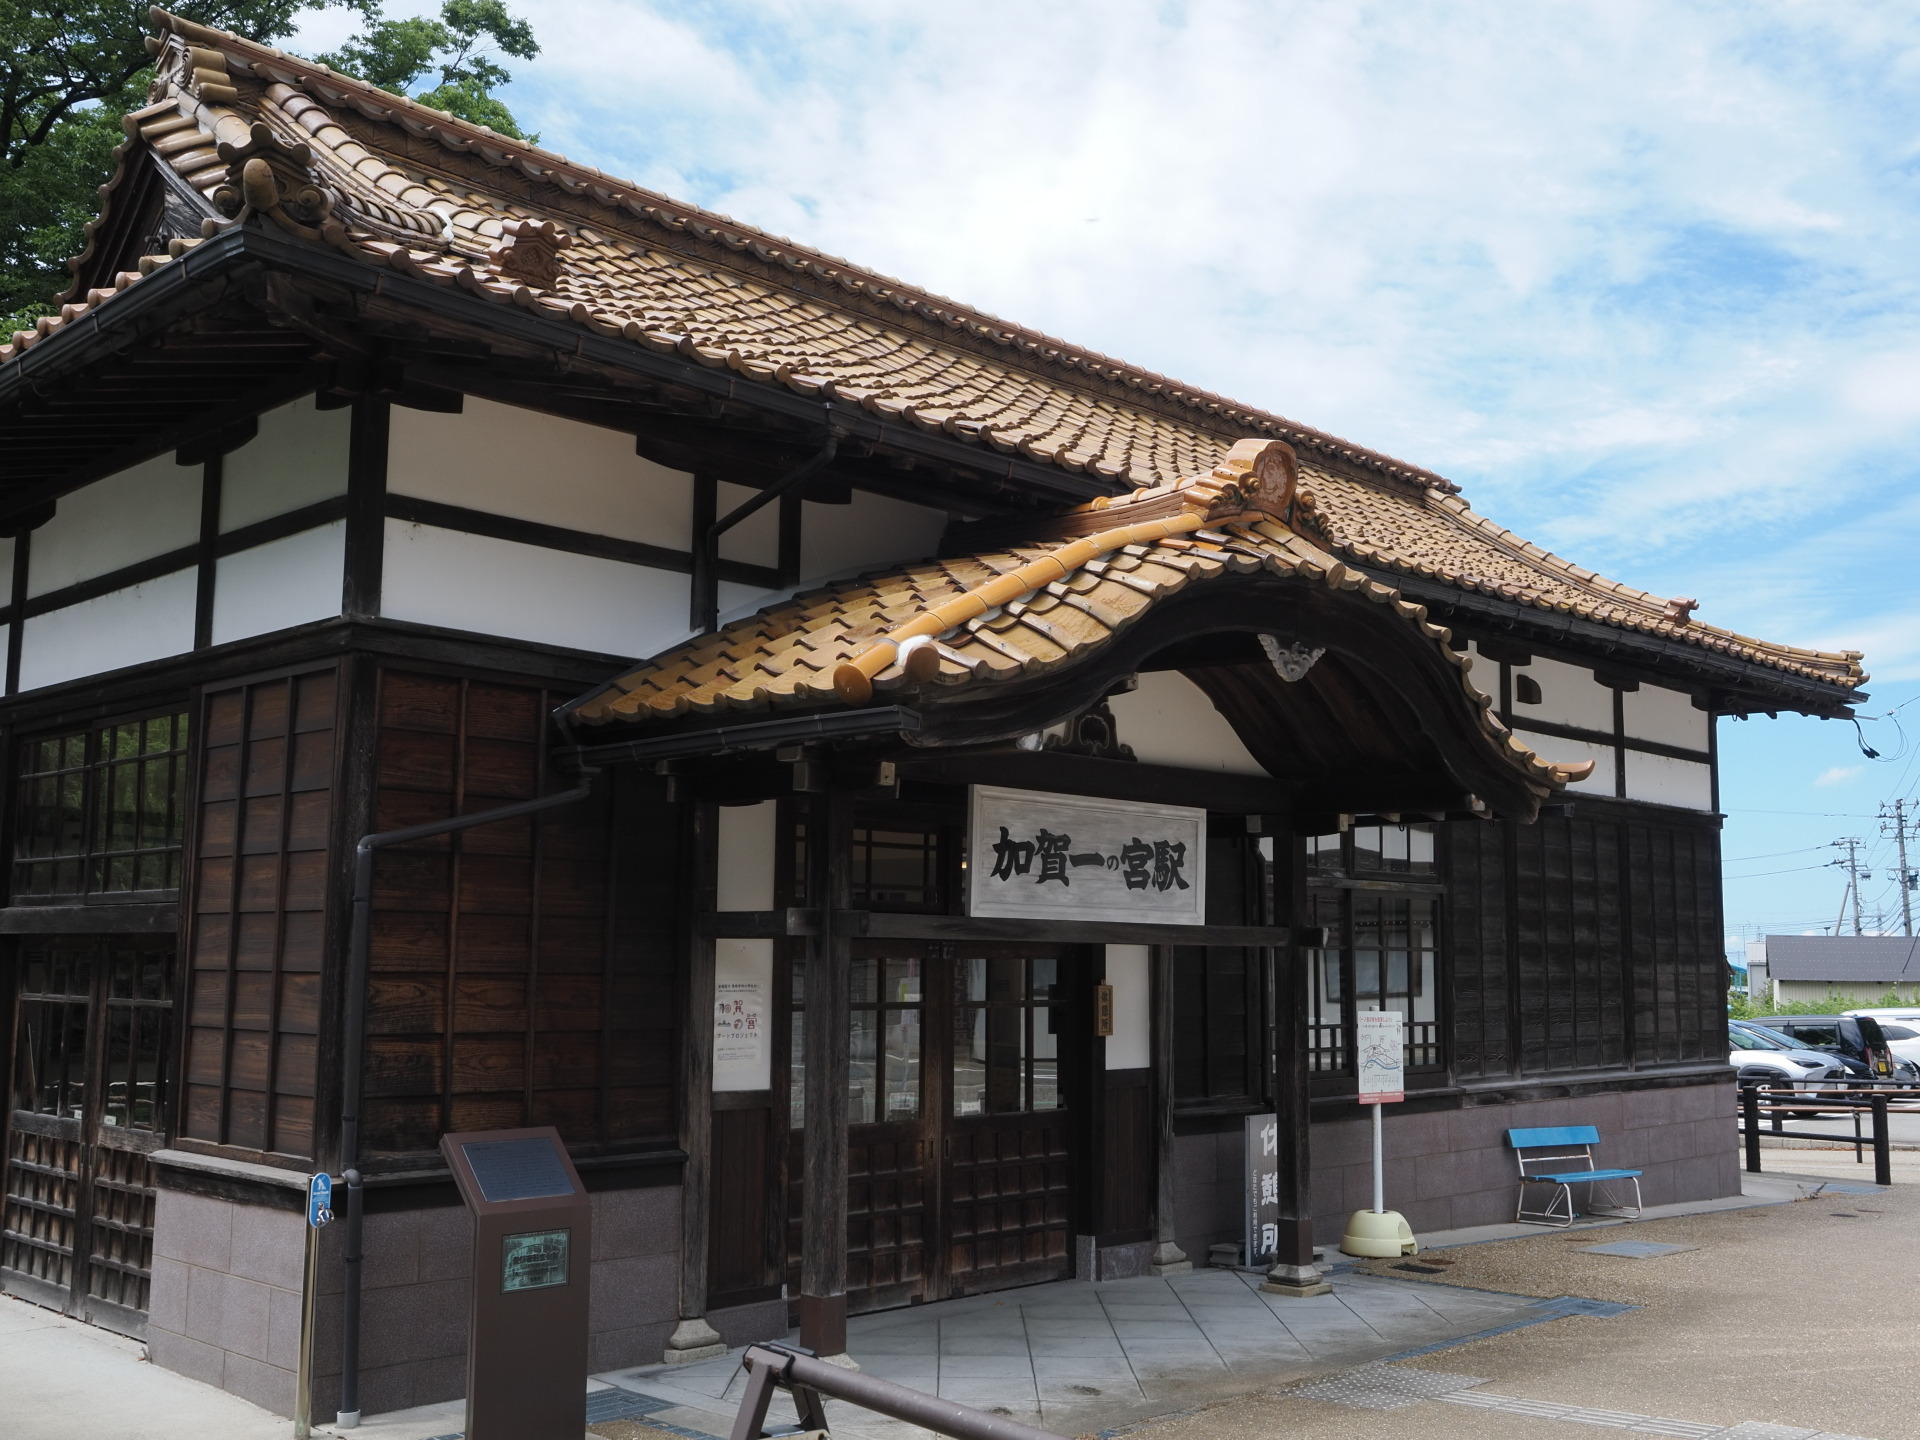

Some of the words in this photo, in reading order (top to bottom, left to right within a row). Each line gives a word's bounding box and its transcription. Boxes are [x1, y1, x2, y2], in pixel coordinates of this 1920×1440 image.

[990, 826, 1190, 892] 加賀一の宮駅
